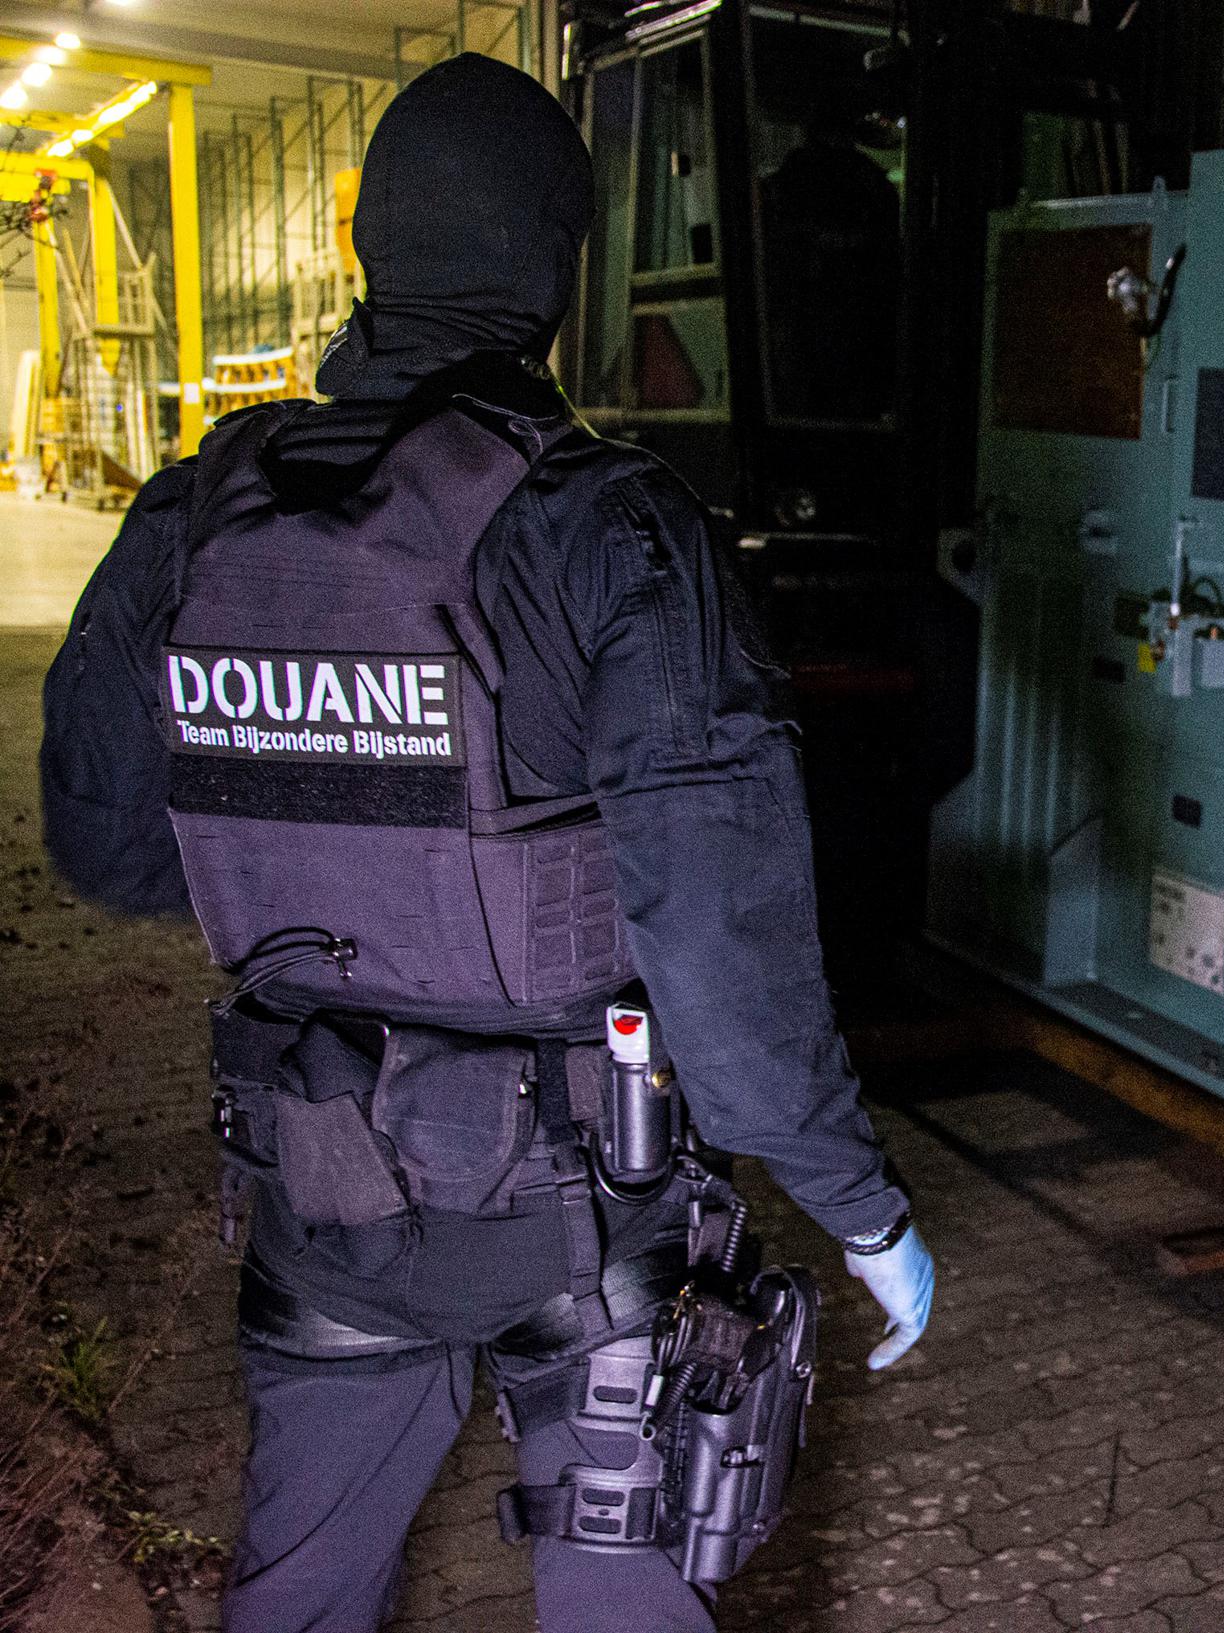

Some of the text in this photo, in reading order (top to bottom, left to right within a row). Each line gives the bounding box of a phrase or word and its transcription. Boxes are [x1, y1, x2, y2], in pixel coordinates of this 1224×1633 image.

[168, 655, 449, 725] DOUANE
[176, 719, 452, 759] Team Bijzondere Bijstand
